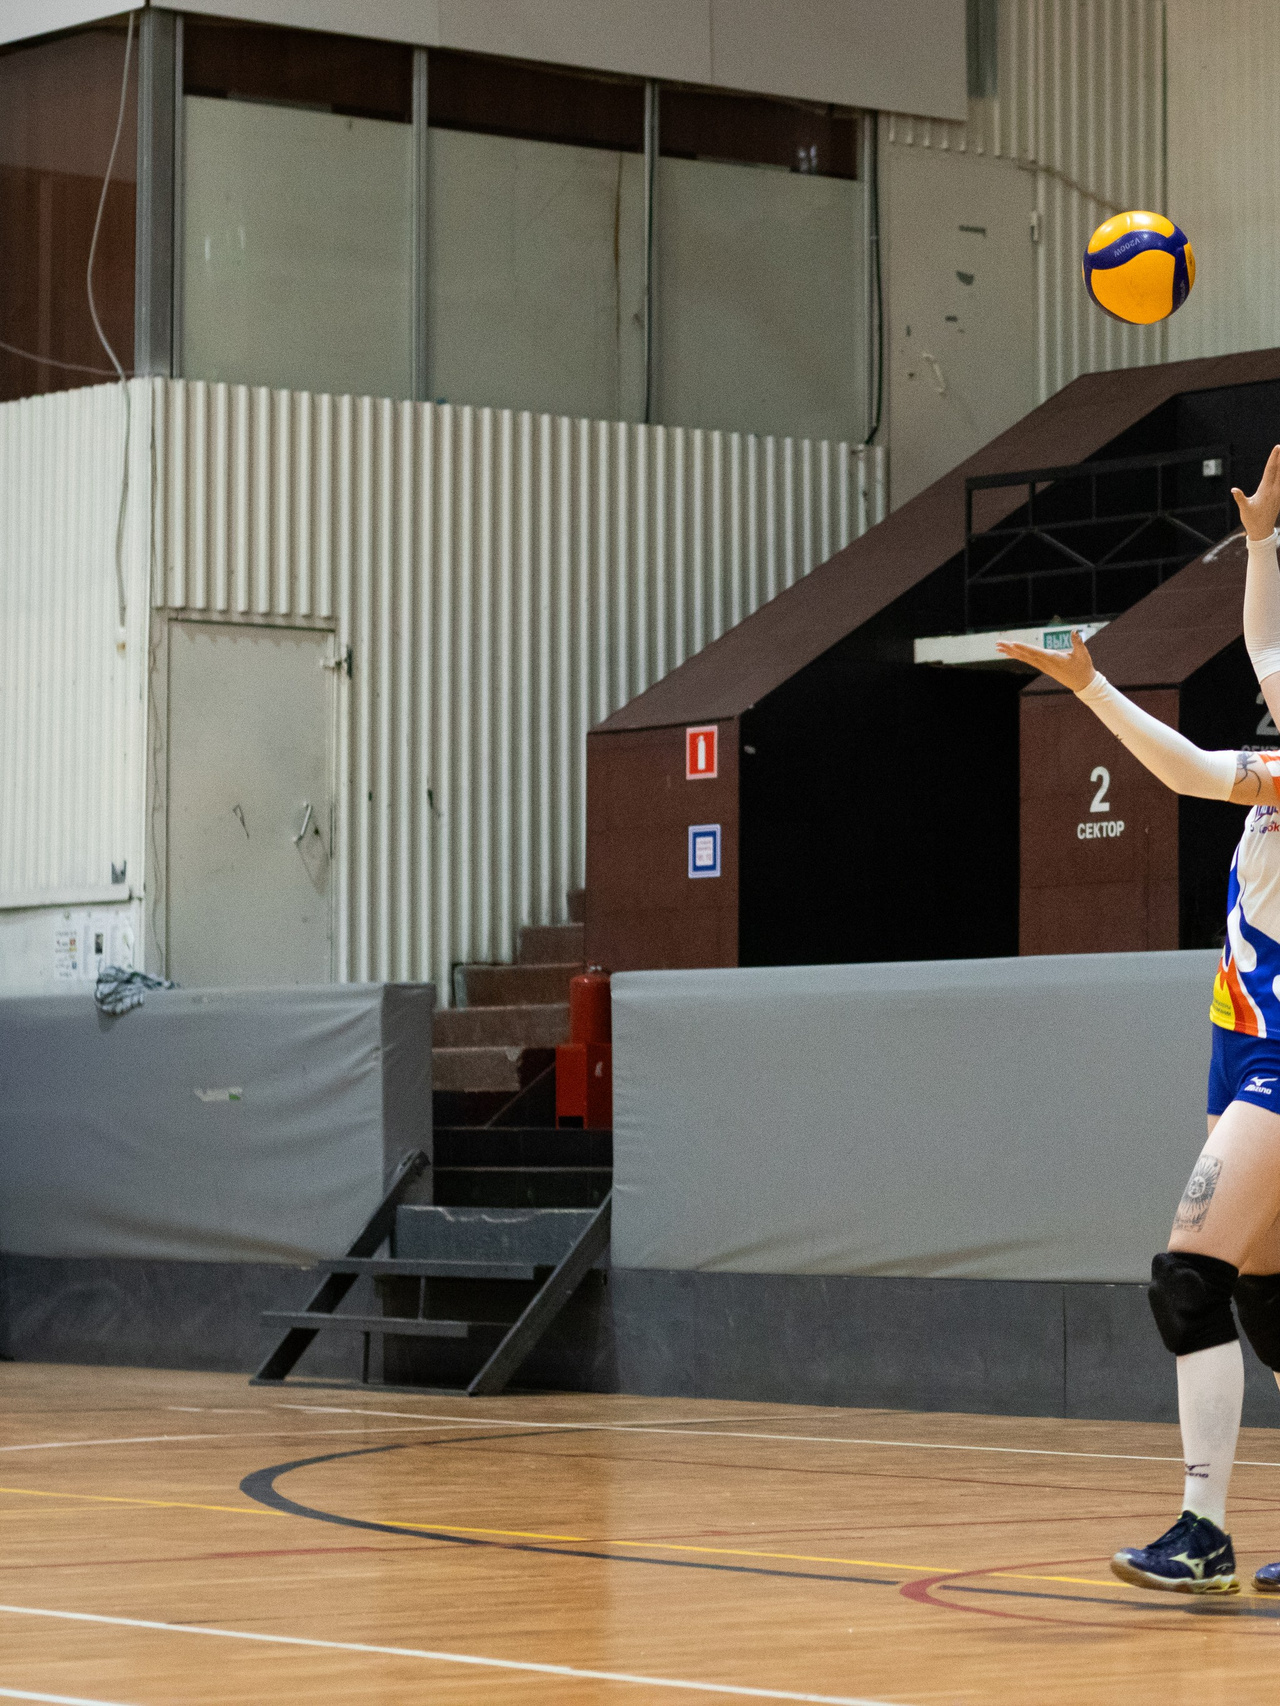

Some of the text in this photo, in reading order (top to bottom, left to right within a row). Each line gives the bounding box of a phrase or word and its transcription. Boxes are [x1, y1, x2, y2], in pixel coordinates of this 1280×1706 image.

[1046, 632, 1072, 650] ВЫХ
[1089, 765, 1110, 813] 2
[1077, 820, 1125, 840] СЕКТОР
